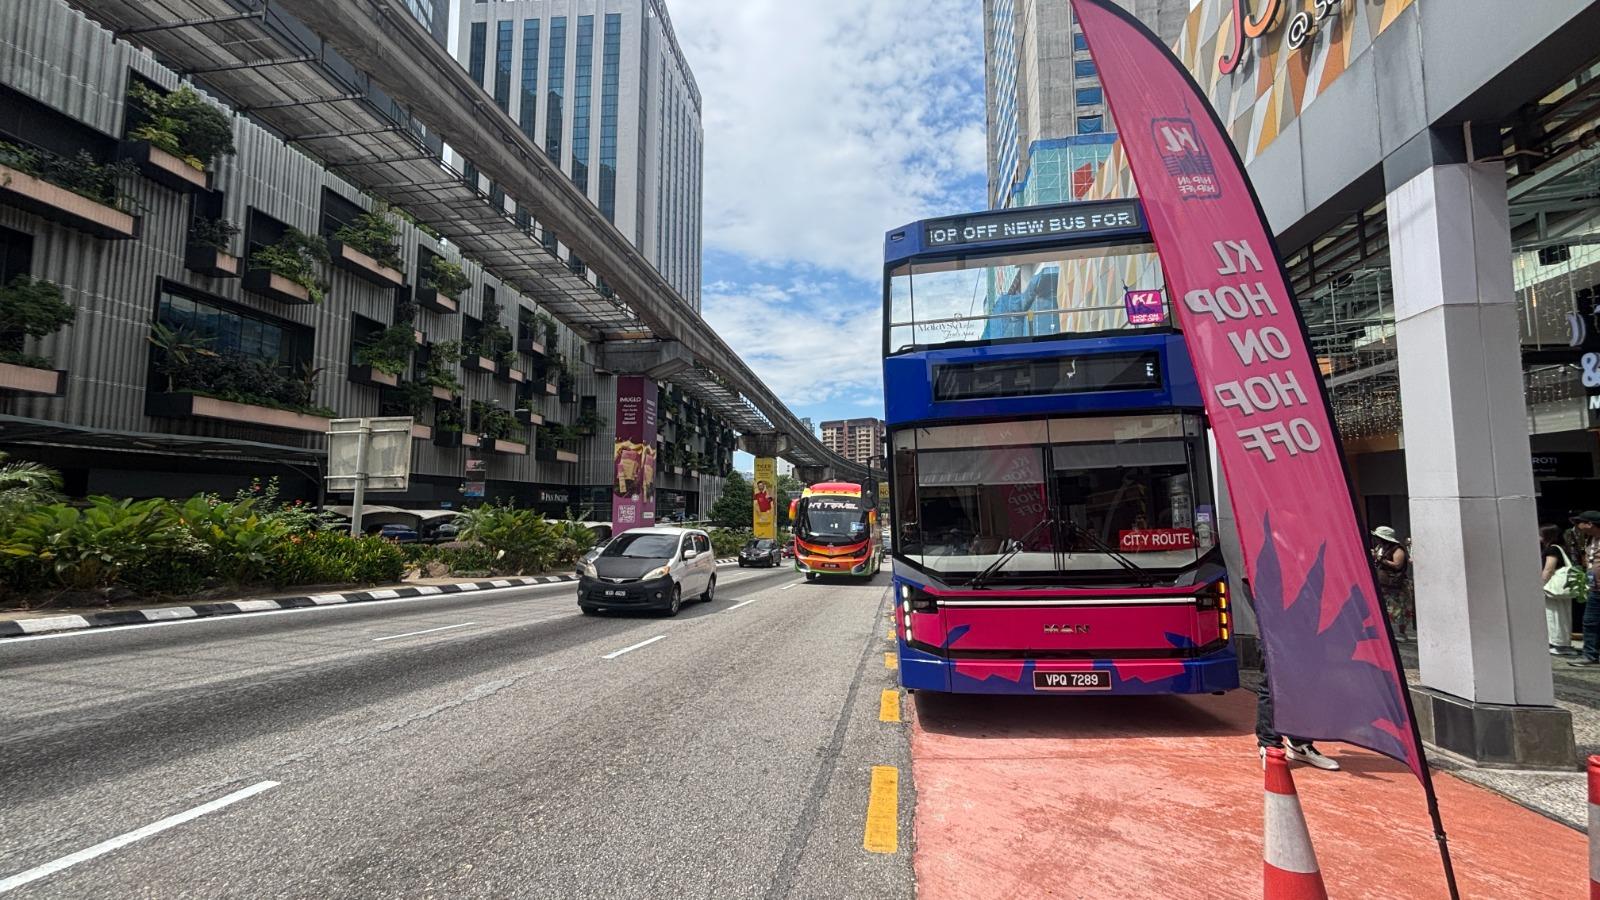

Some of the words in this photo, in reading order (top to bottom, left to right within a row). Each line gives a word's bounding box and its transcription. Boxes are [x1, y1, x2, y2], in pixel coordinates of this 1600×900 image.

[963, 224, 997, 240] OFF
[1003, 219, 1044, 236] NEW
[1049, 215, 1086, 232] BUS
[1091, 211, 1132, 228] FOR
[1131, 293, 1159, 306] KL
[1123, 534, 1149, 546] CITY
[1152, 532, 1191, 546] ROUTE
[1043, 623, 1091, 634] MAN
[1045, 673, 1068, 686] VPQ
[1070, 673, 1099, 686] 7289
